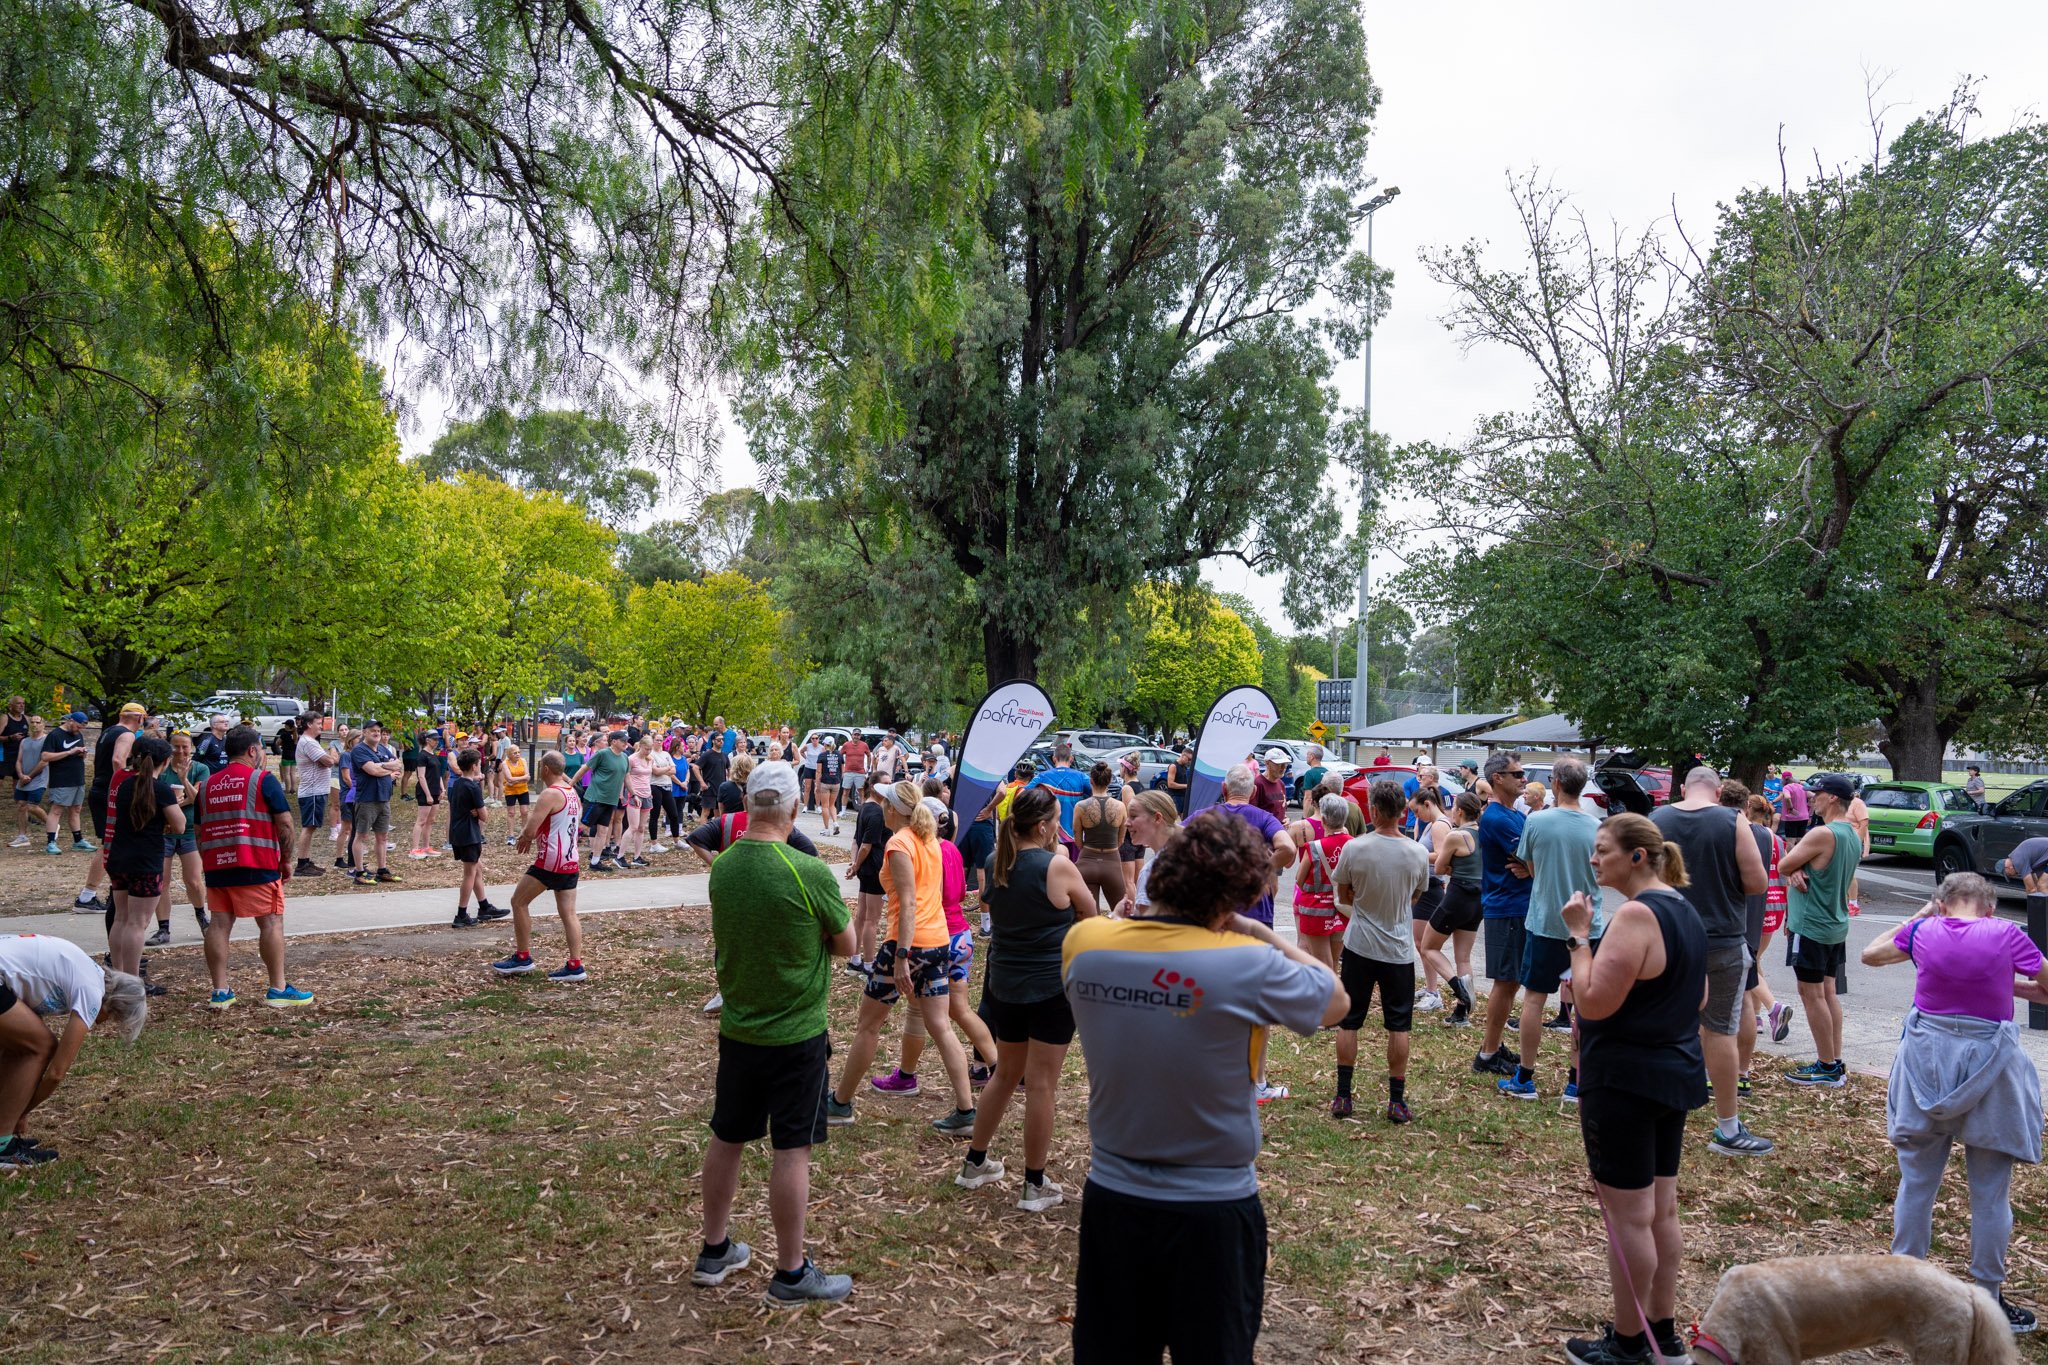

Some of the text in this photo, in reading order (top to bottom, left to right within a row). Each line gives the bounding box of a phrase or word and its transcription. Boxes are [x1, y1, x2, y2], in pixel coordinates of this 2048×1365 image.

[980, 699, 1042, 730] parkrun
[1018, 708, 1044, 717] medibank
[1211, 702, 1268, 731] parkrun
[209, 774, 245, 794] parkrun
[208, 794, 243, 805] VOLUNTEER
[1076, 980, 1191, 1008] CITYCIRCLE
